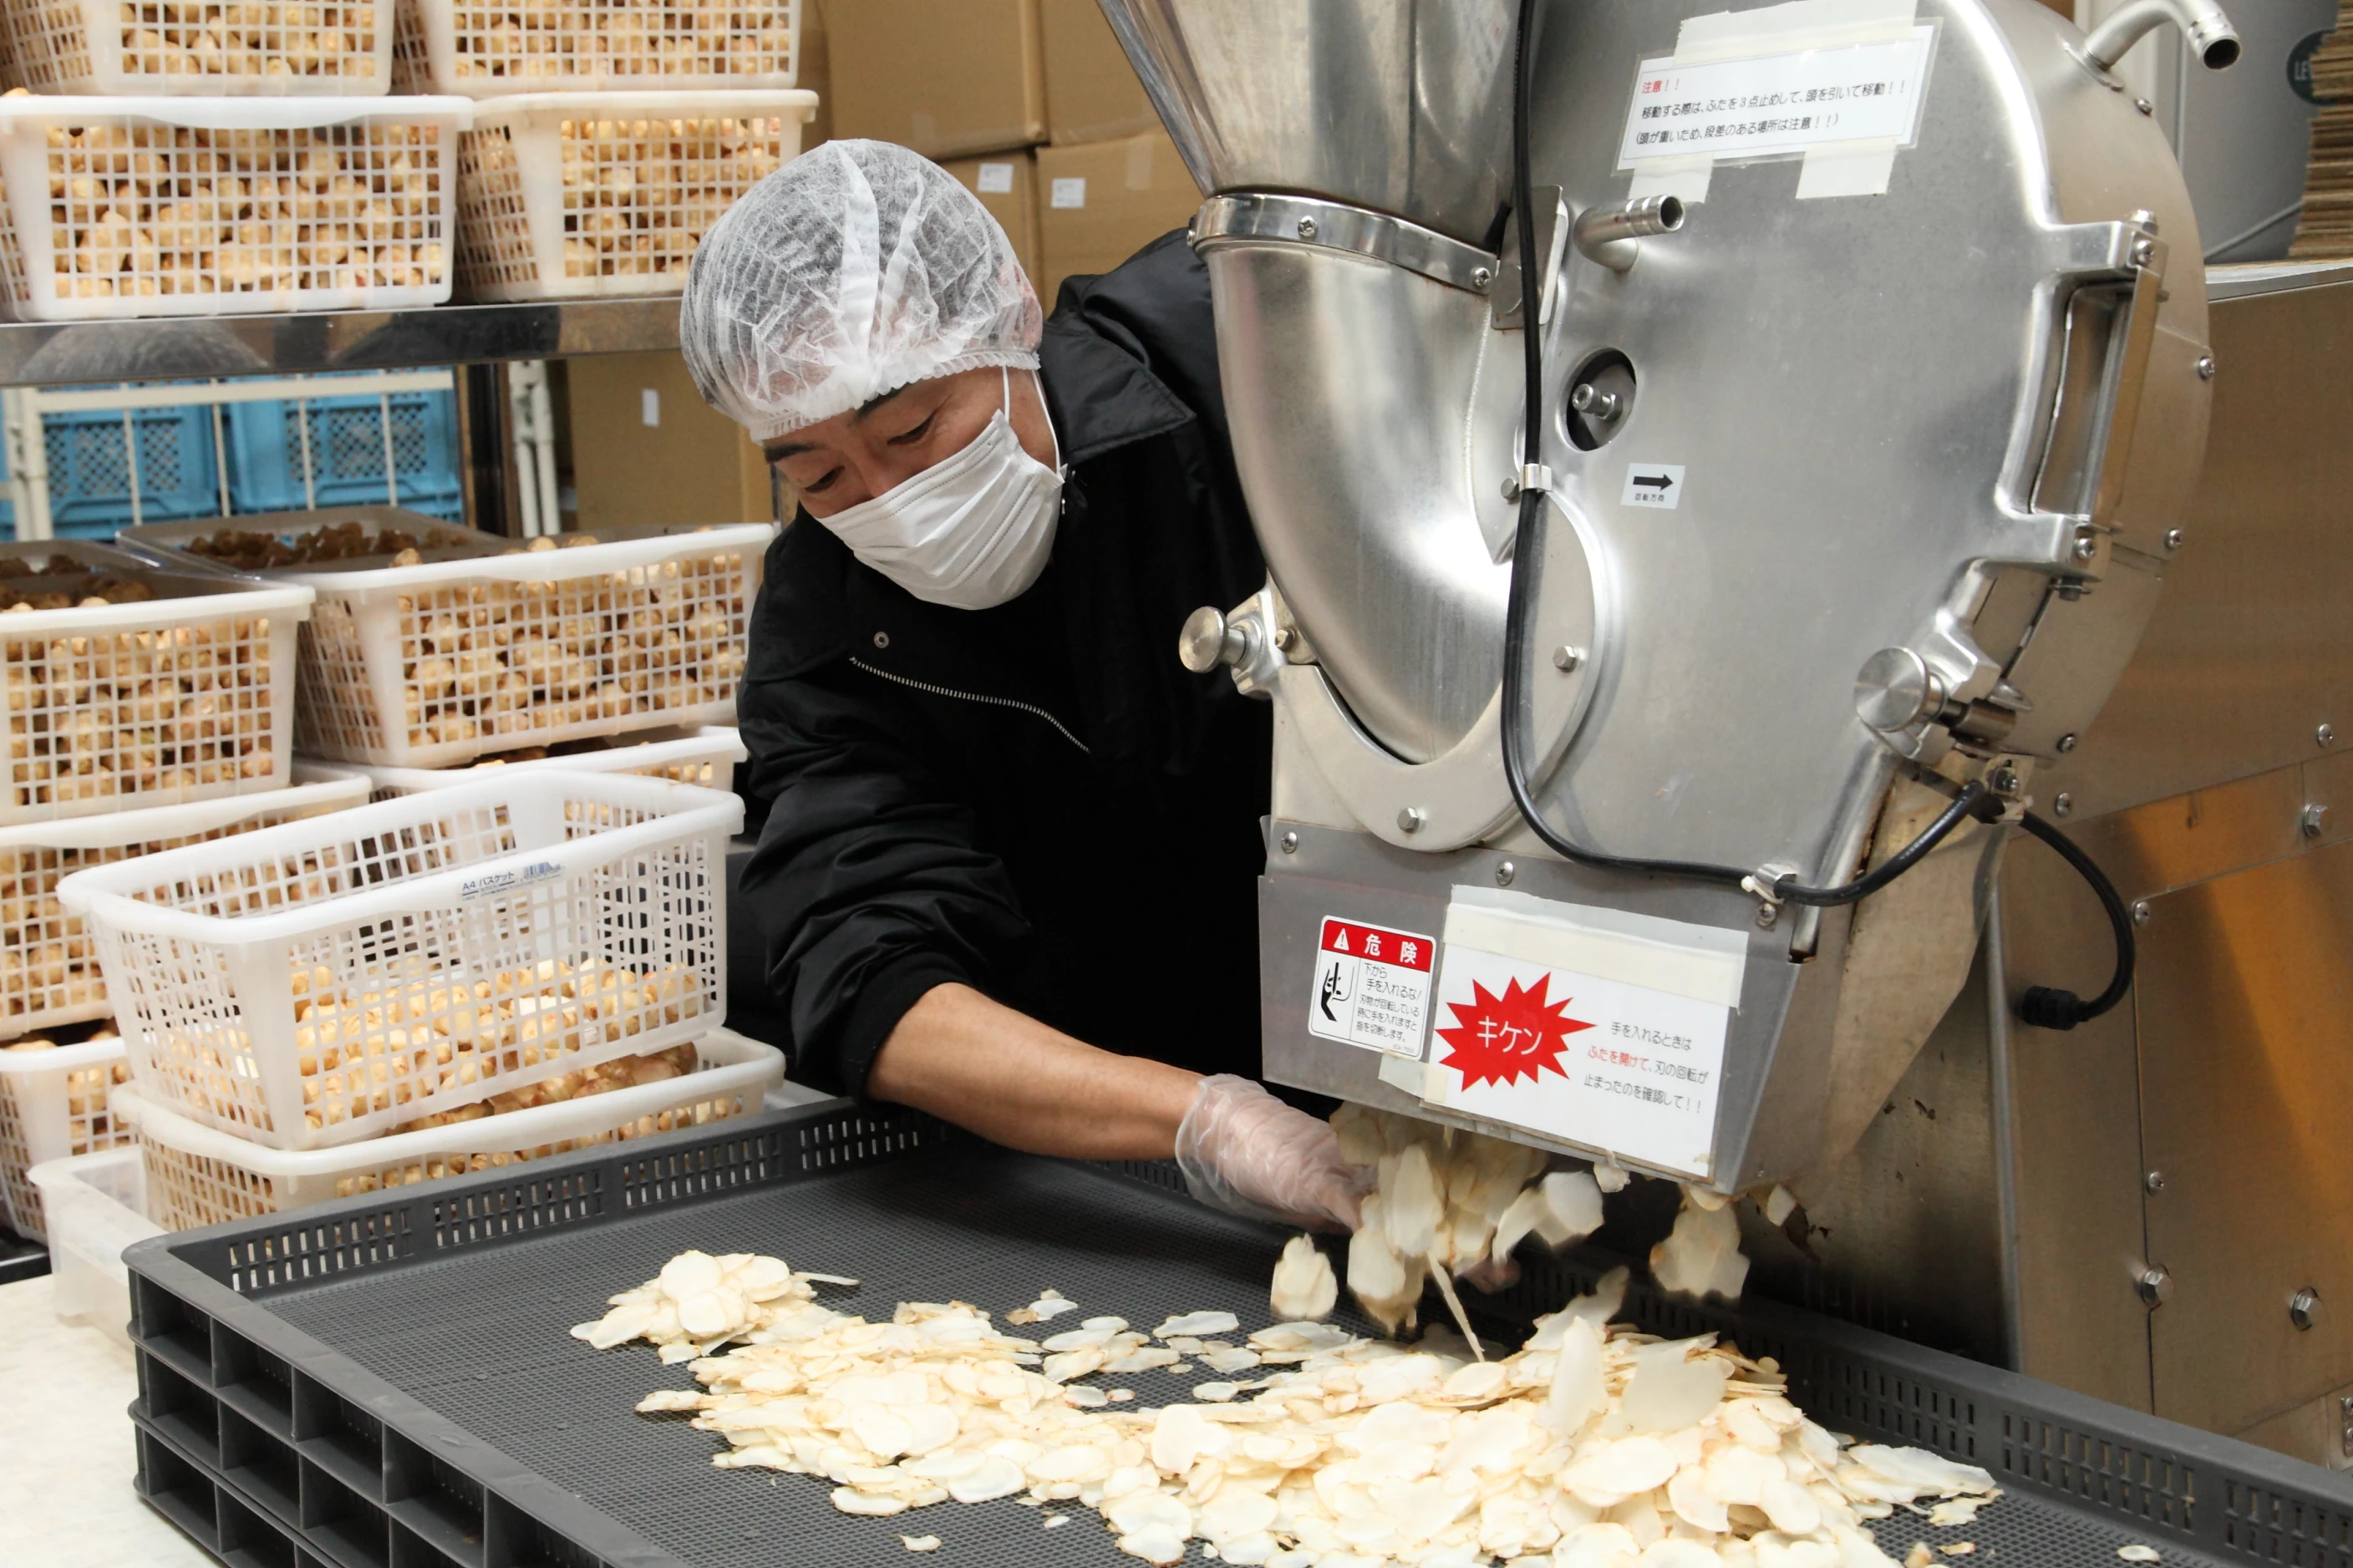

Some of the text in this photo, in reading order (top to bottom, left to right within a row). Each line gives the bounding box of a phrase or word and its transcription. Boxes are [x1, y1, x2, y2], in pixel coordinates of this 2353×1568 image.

[463, 880, 475, 891] A4
[1364, 962, 1387, 978] 下から
[1476, 1015, 1542, 1055] キケン
[1611, 1022, 1691, 1051] 手を入れるときは
